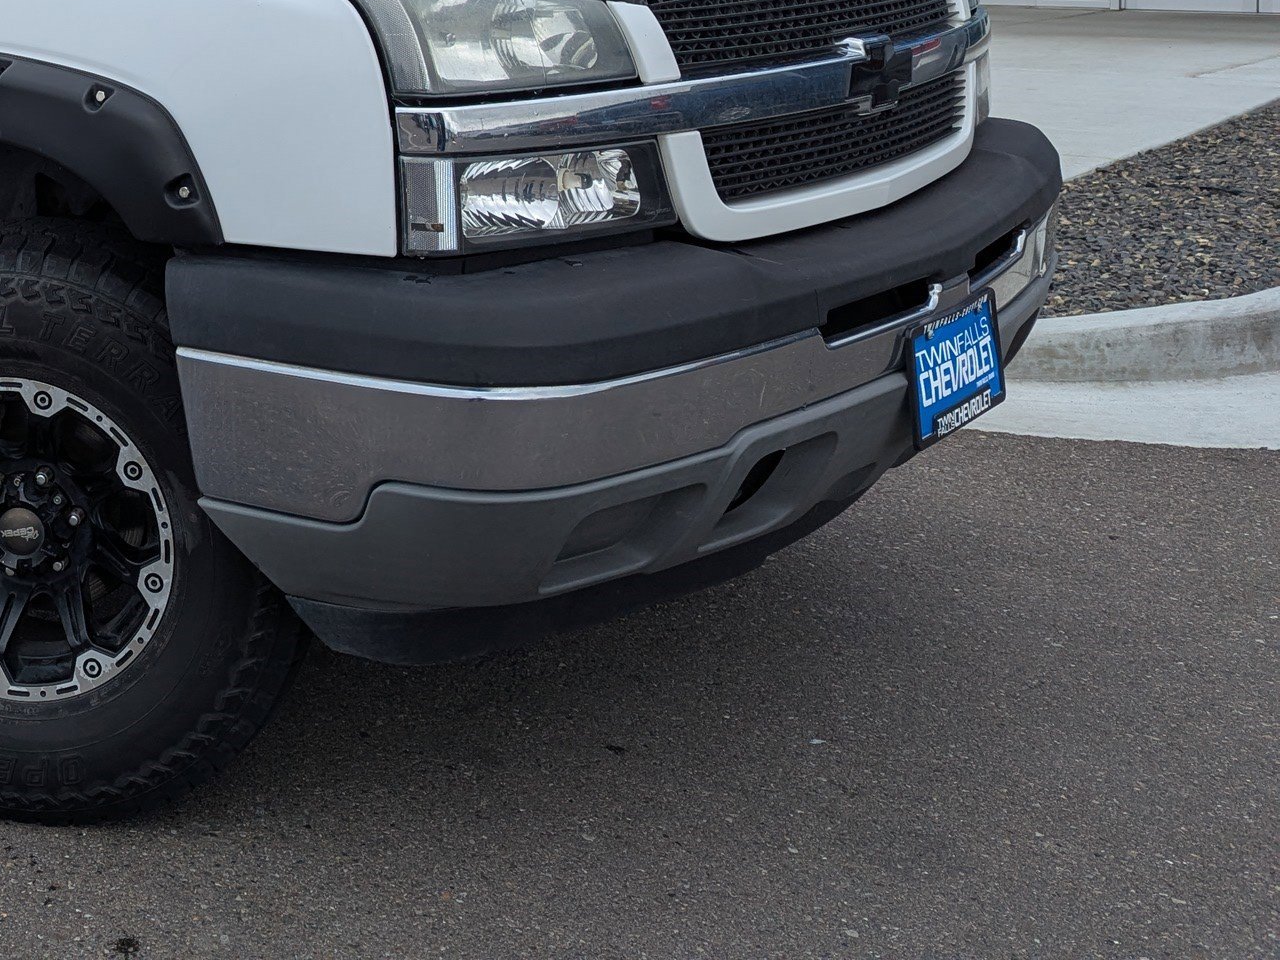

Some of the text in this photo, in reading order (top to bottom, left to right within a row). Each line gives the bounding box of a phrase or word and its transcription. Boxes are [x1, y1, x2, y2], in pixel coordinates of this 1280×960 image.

[915, 316, 990, 372] TWINFALLS
[919, 335, 995, 408] CHEVROLET
[954, 388, 992, 428] CHEVROLET
